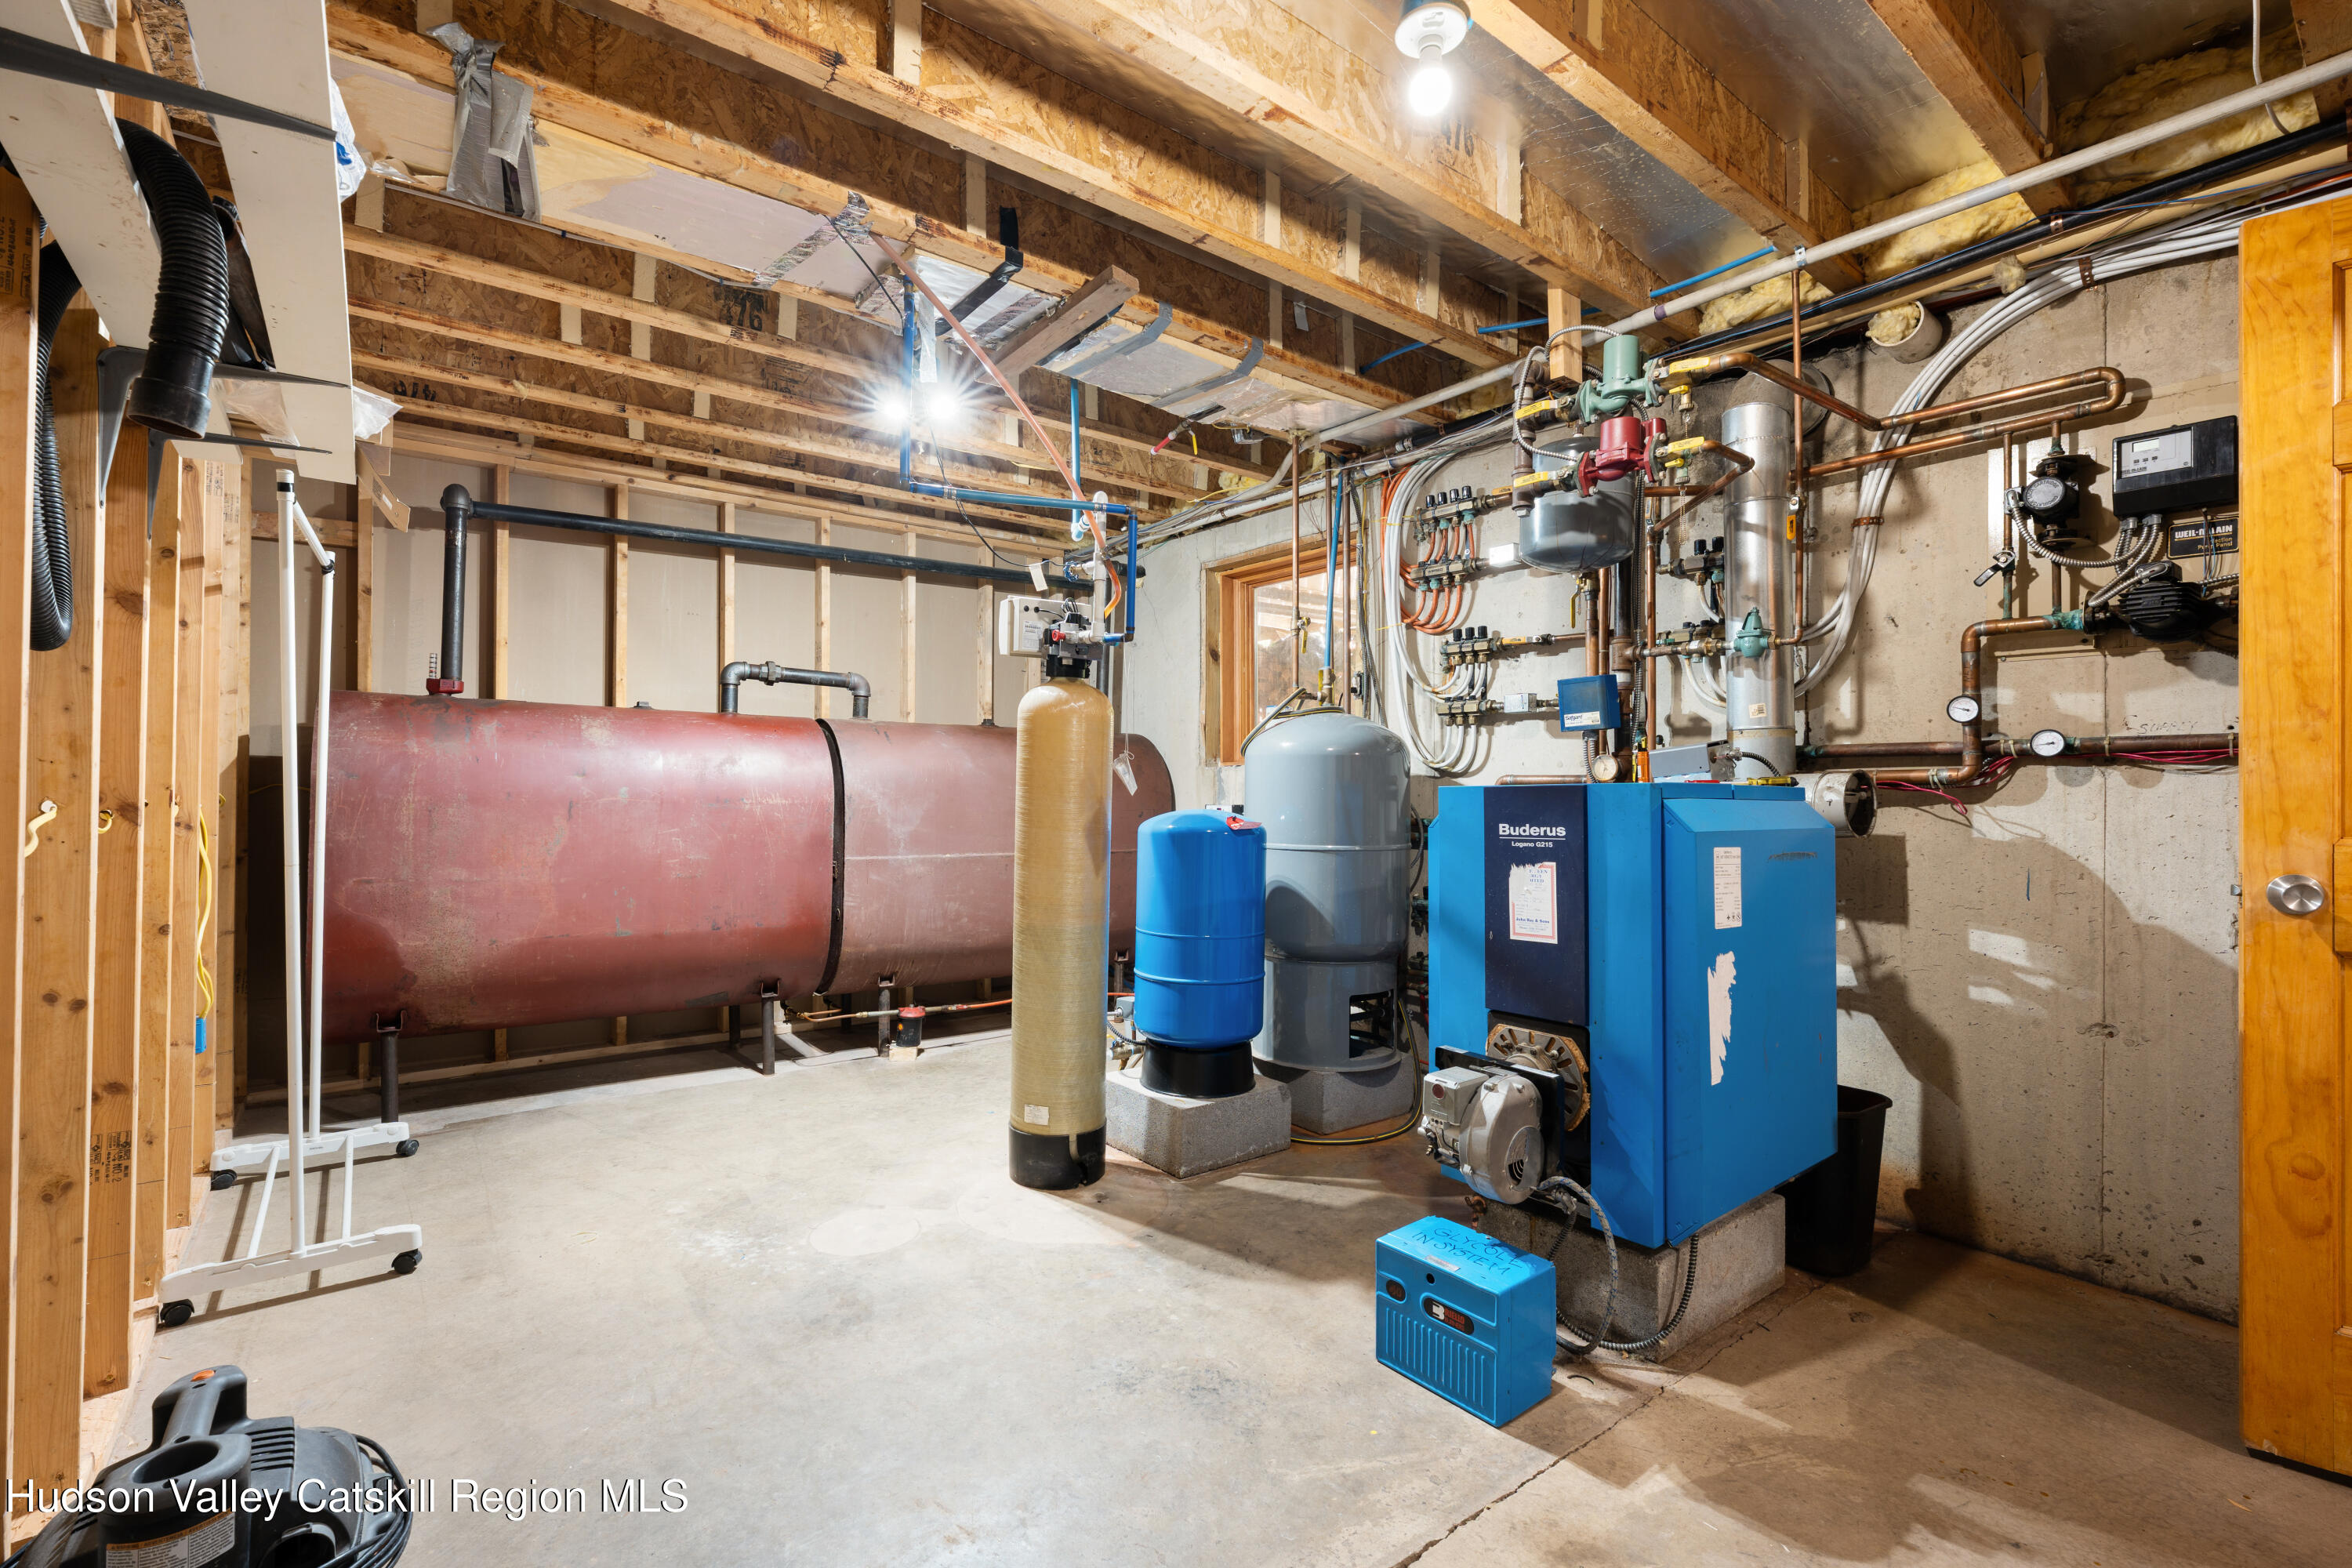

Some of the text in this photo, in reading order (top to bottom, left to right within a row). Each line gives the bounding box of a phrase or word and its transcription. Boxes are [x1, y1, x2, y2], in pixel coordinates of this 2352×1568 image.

[2137, 720, 2199, 735] SUPPLY
[1498, 823, 1566, 837] Buderus
[1411, 1232, 1435, 1244] IN
[1433, 1242, 1512, 1276] SYSTEM
[1444, 1306, 1465, 1324] RIELLO
